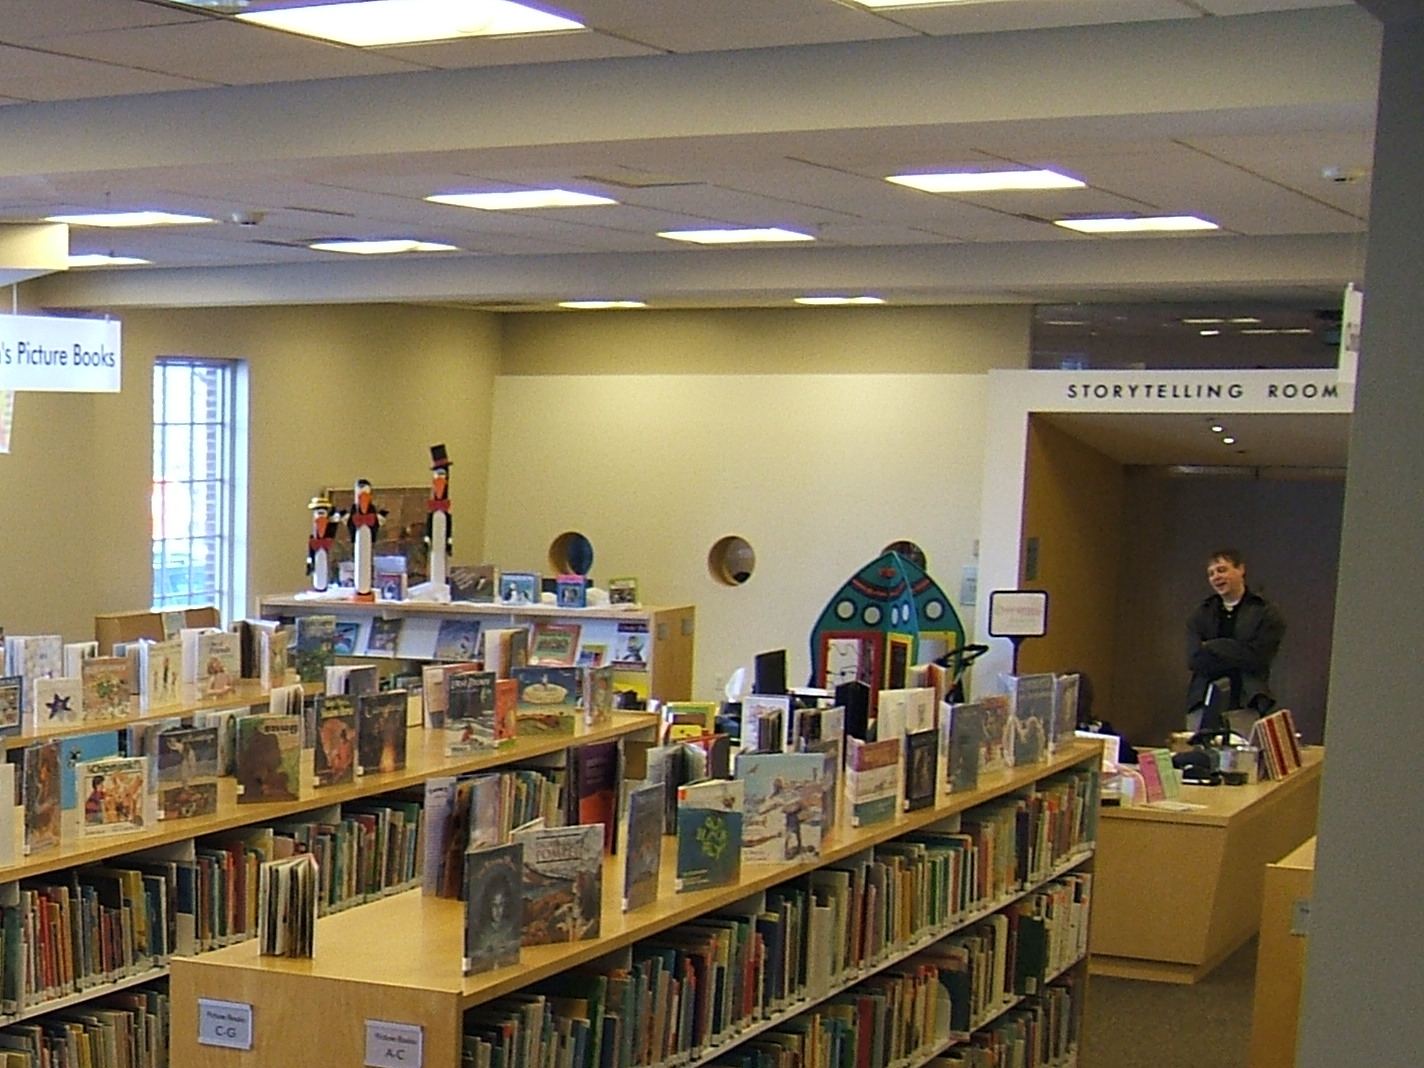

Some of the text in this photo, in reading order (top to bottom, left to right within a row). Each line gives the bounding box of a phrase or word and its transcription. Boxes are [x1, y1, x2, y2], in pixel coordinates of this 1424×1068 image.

[17, 341, 68, 366] Picture
[72, 343, 116, 368] Books
[1067, 383, 1339, 399] STORYTELLING ROOM
[206, 1010, 226, 1020] Picture
[214, 1025, 237, 1038] C-G
[375, 1032, 397, 1043] Picture
[384, 1049, 406, 1061] A-C
